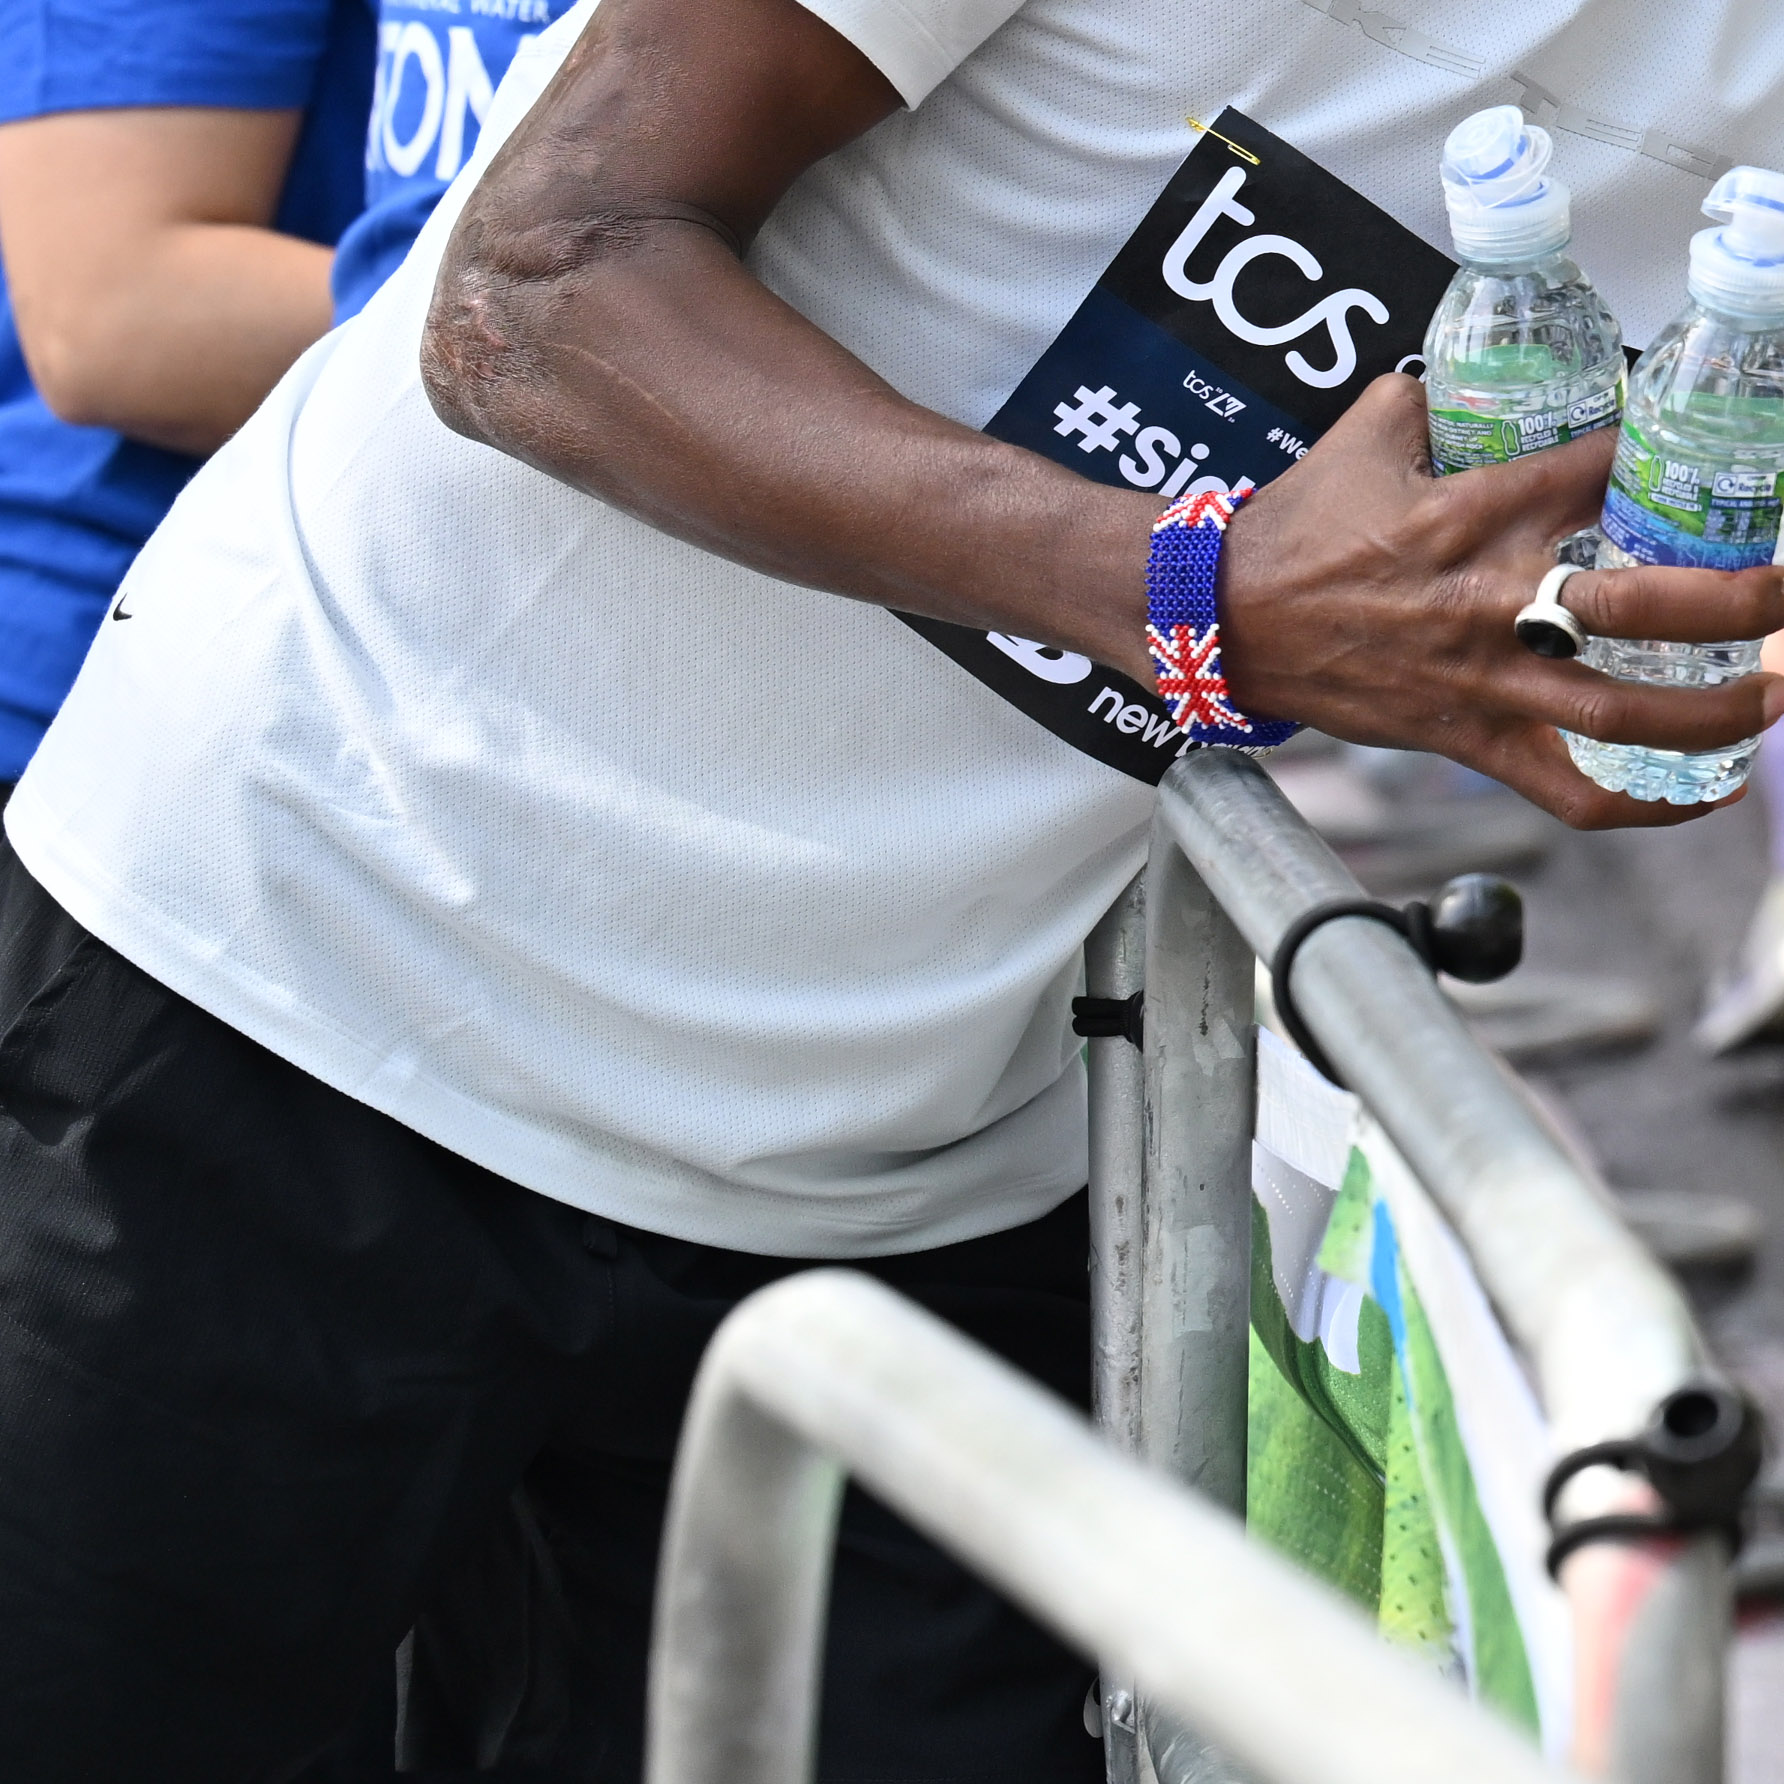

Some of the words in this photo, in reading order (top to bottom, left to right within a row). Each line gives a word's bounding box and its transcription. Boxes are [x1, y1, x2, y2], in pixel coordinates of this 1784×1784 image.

[1162, 165, 1390, 389] tcs
[1183, 369, 1214, 400] tcs
[1518, 411, 1557, 436] 100%
[1664, 460, 1700, 484] 100%
[1087, 686, 1182, 749] new
